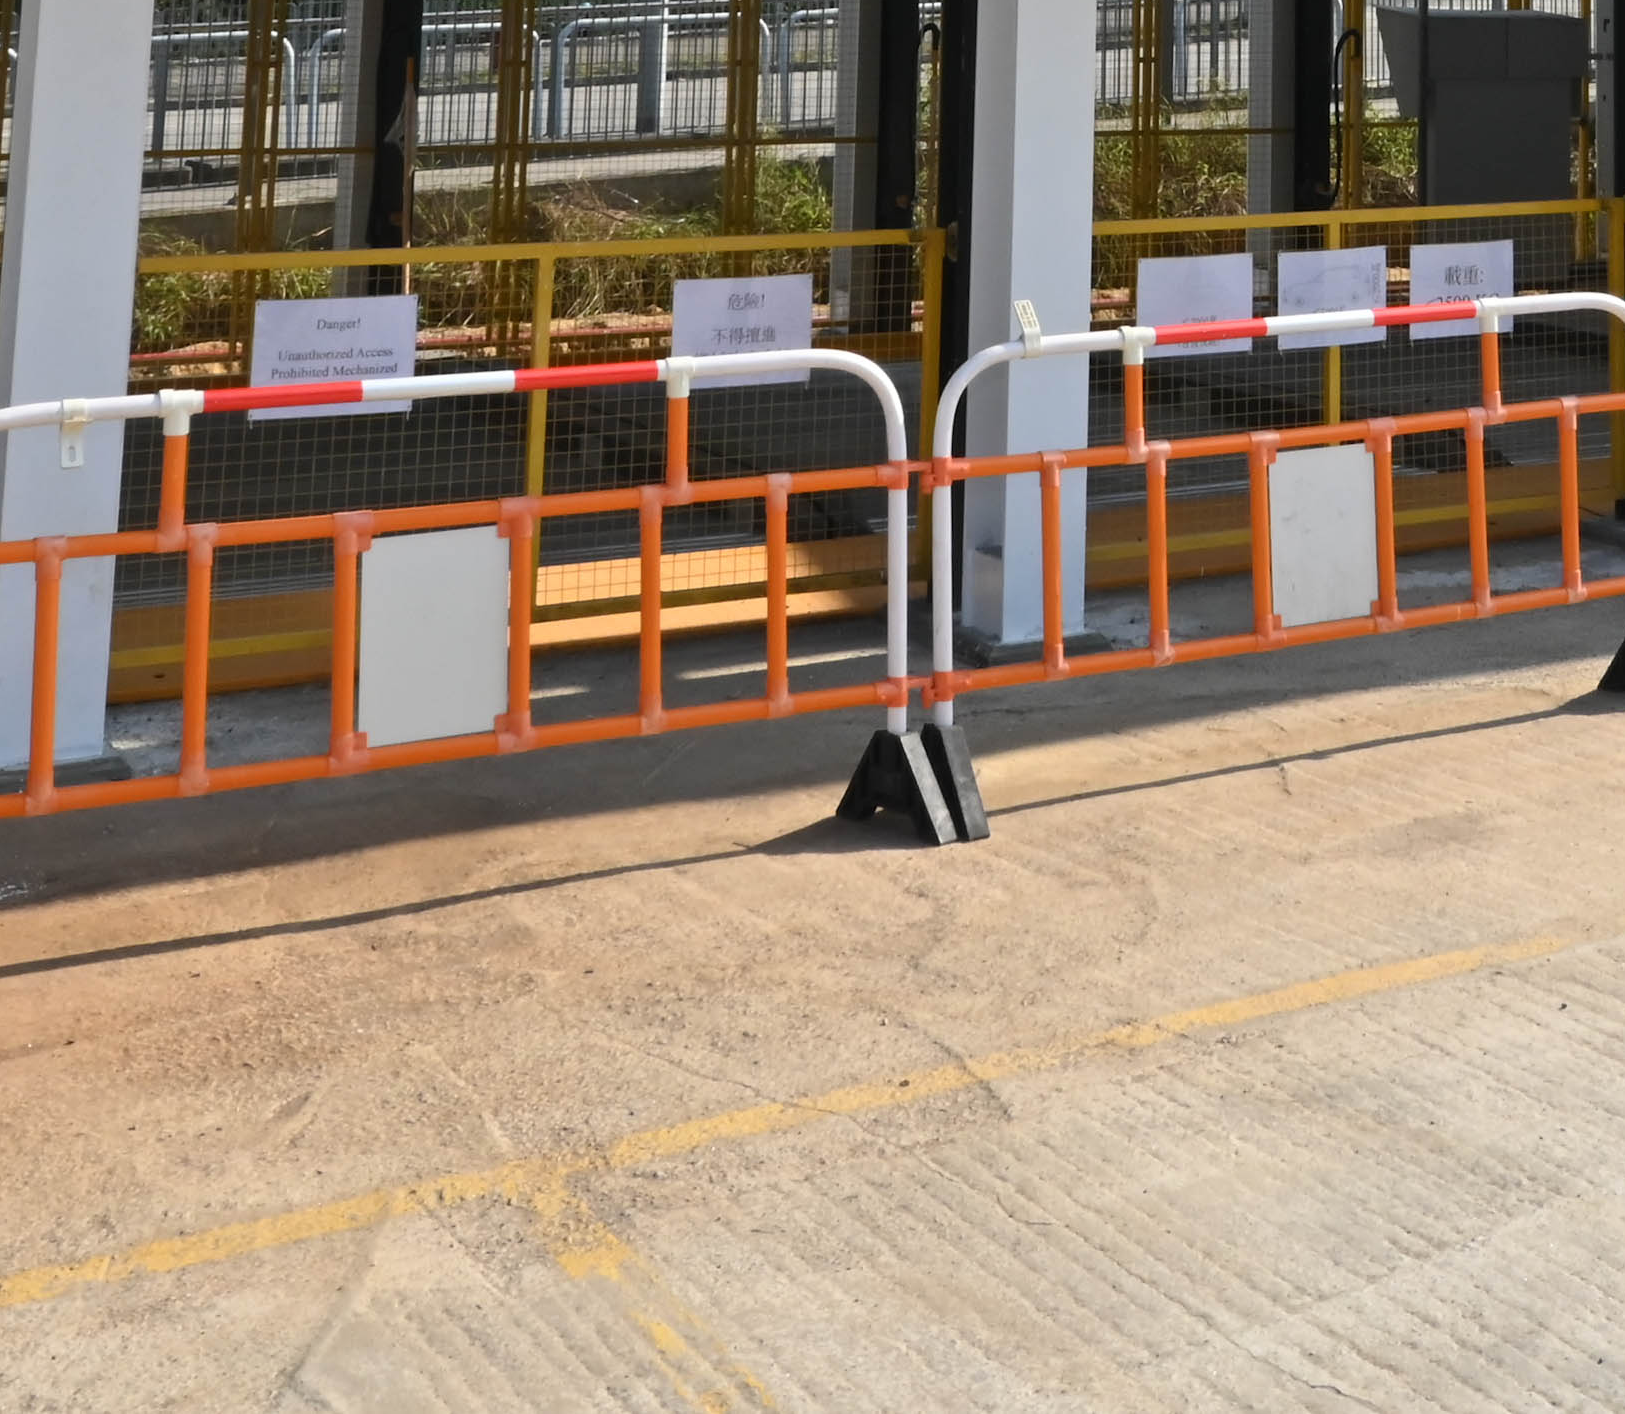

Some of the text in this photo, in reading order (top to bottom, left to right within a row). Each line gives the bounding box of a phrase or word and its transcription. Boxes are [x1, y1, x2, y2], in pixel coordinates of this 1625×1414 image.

[316, 318, 361, 331] Danger!
[278, 347, 394, 362] Unauthorized Access
[271, 363, 399, 380] Prohibited Mechanized
